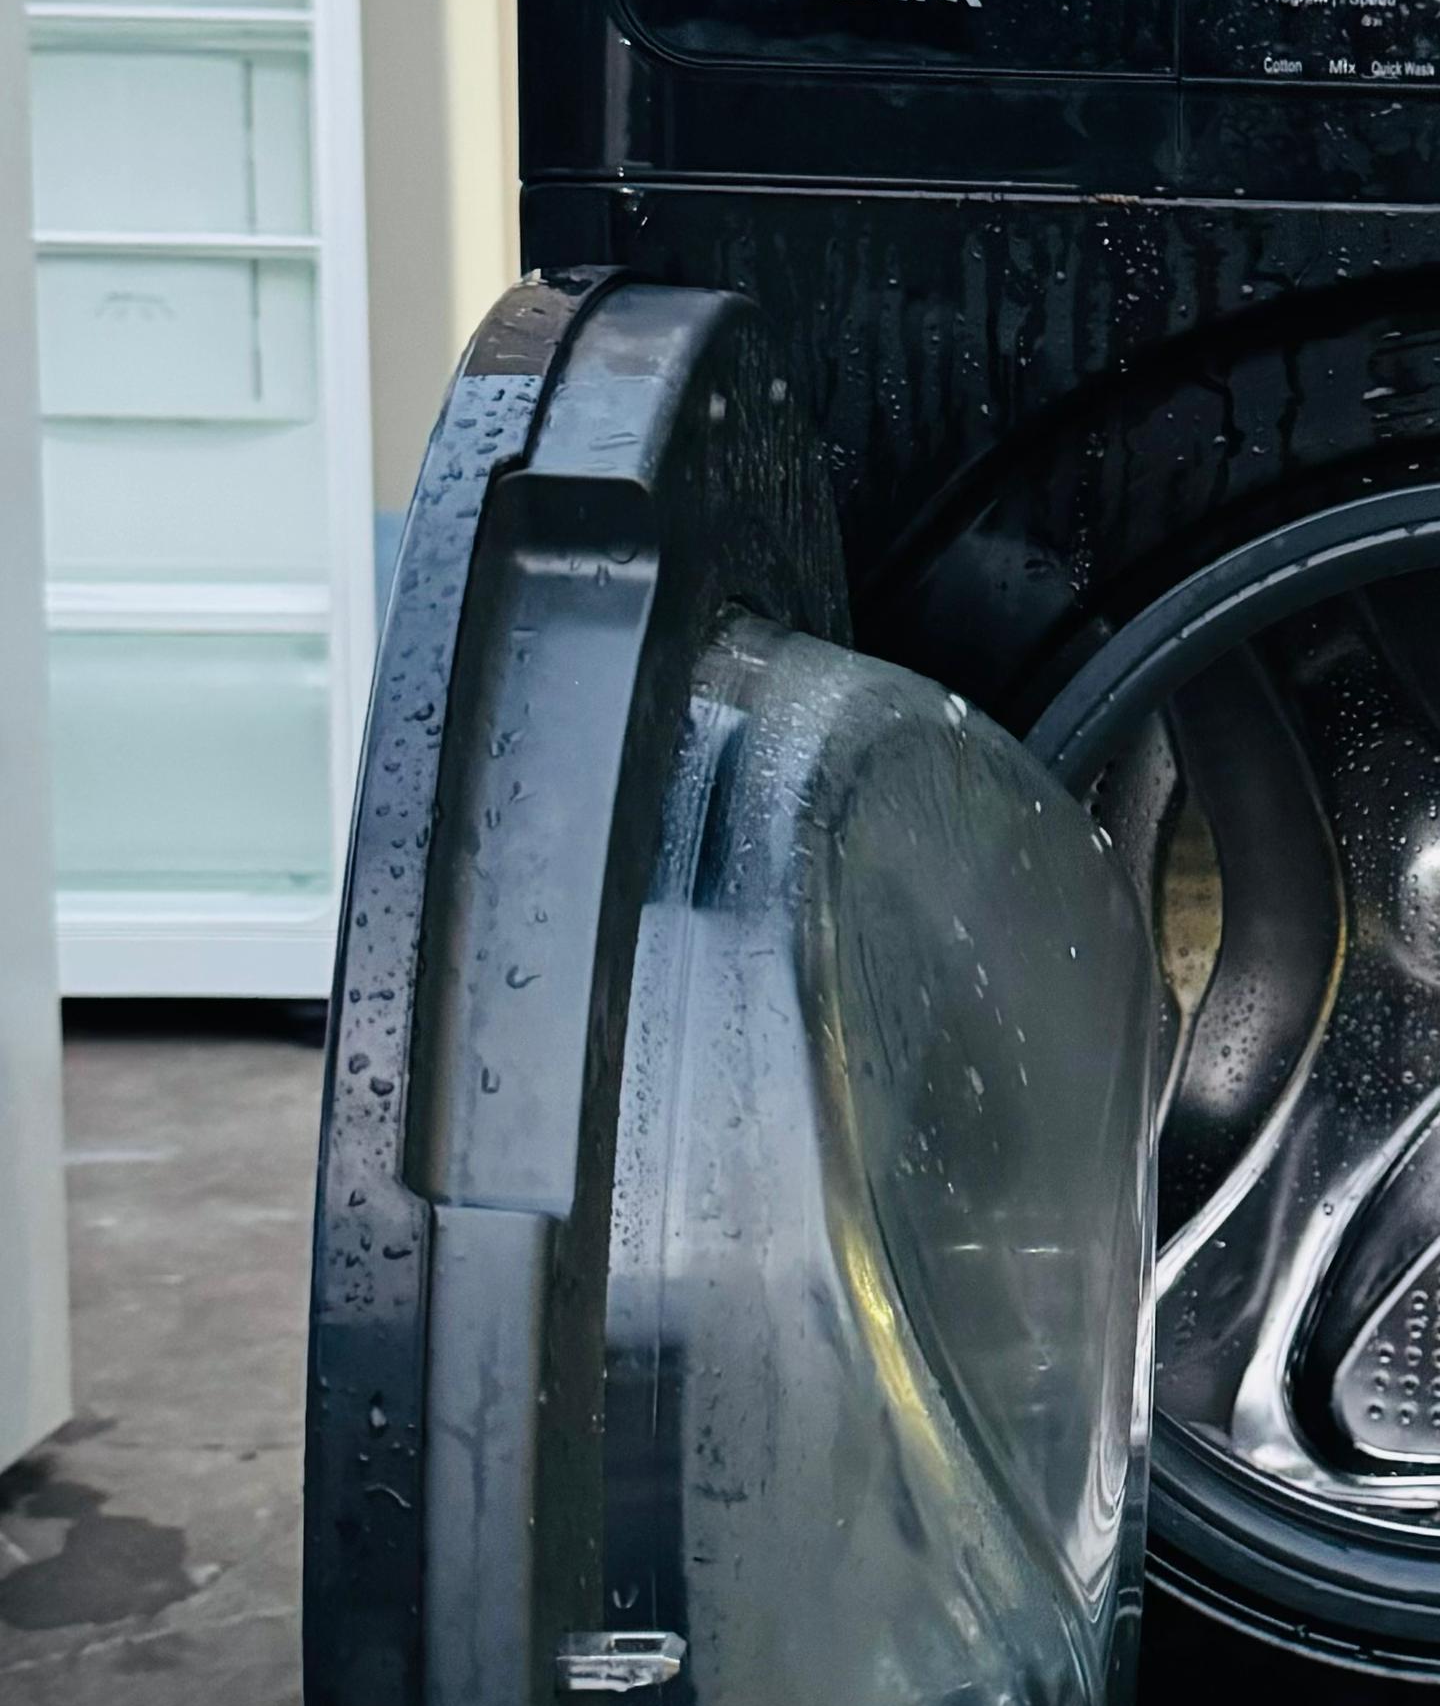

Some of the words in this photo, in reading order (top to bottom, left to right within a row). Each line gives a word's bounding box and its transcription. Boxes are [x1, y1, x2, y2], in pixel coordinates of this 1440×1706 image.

[1264, 57, 1302, 74] Cotton
[1329, 60, 1356, 75] Mix
[1371, 61, 1402, 76] Quick
[1404, 62, 1435, 76] Wash
